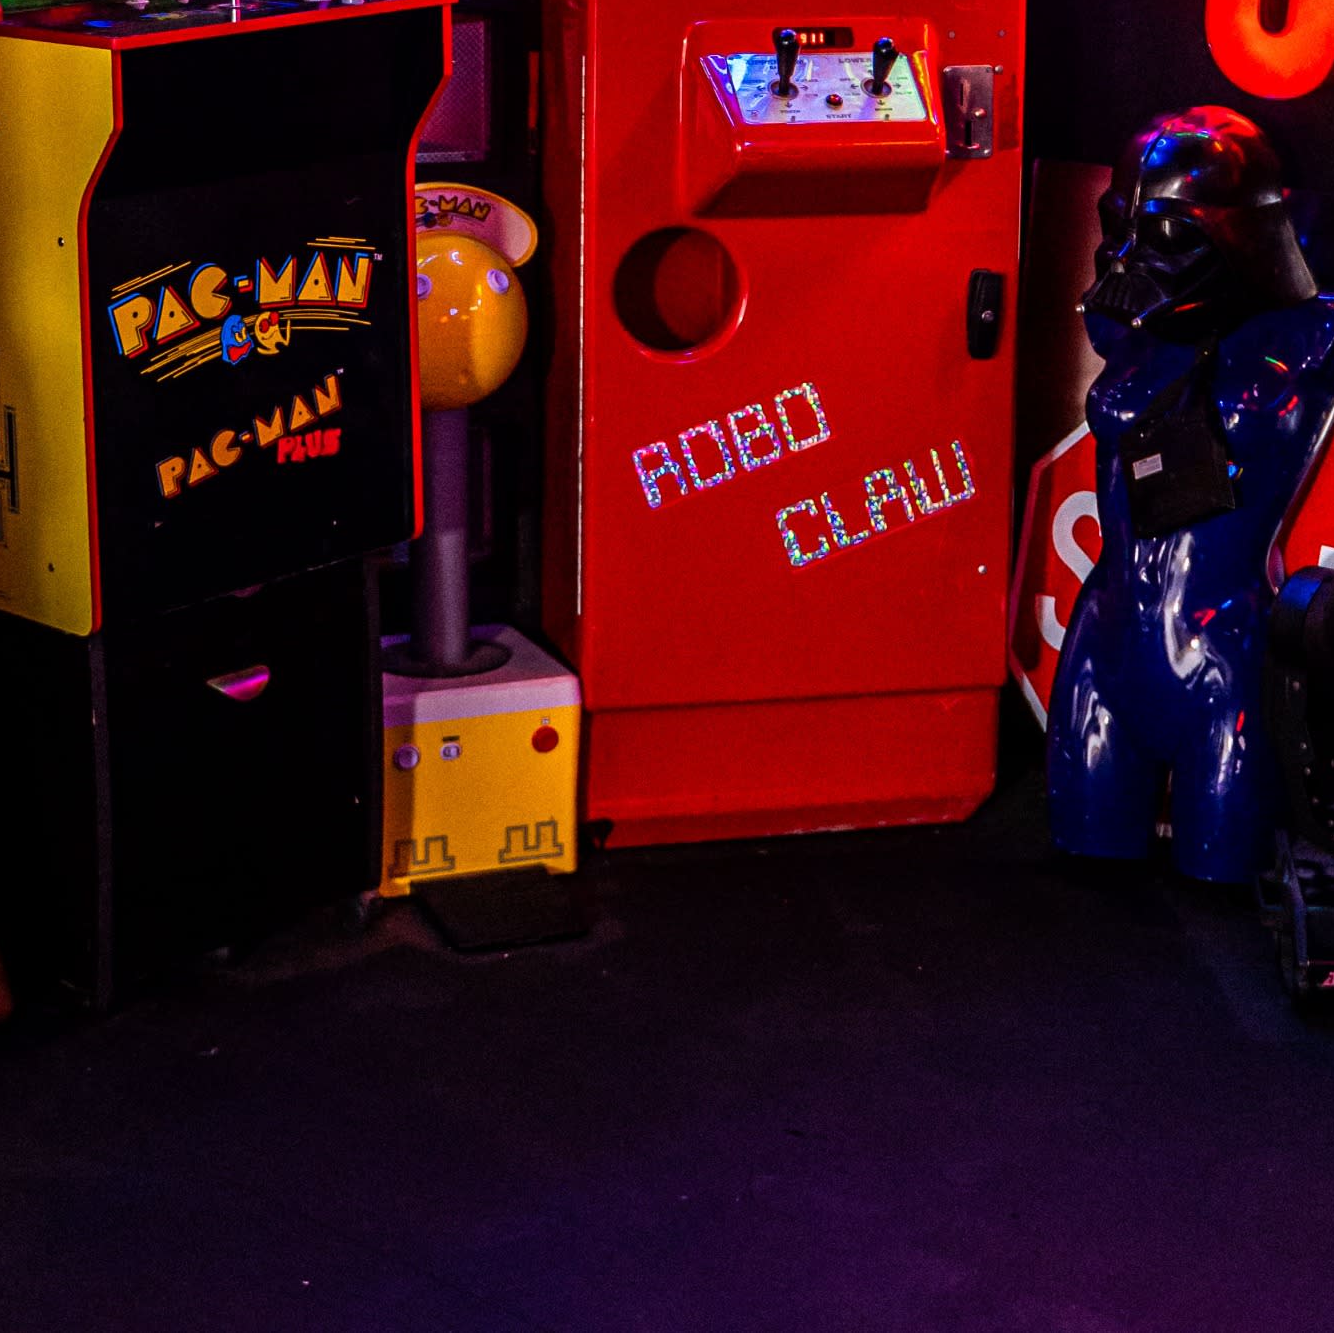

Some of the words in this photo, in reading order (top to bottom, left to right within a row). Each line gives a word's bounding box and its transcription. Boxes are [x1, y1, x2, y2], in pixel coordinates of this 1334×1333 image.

[108, 250, 373, 359] PAC-MAN
[155, 372, 343, 499] PAC-MAN
[276, 428, 343, 465] PLUS
[631, 381, 832, 510] ROBO
[774, 438, 976, 568] CLAW
